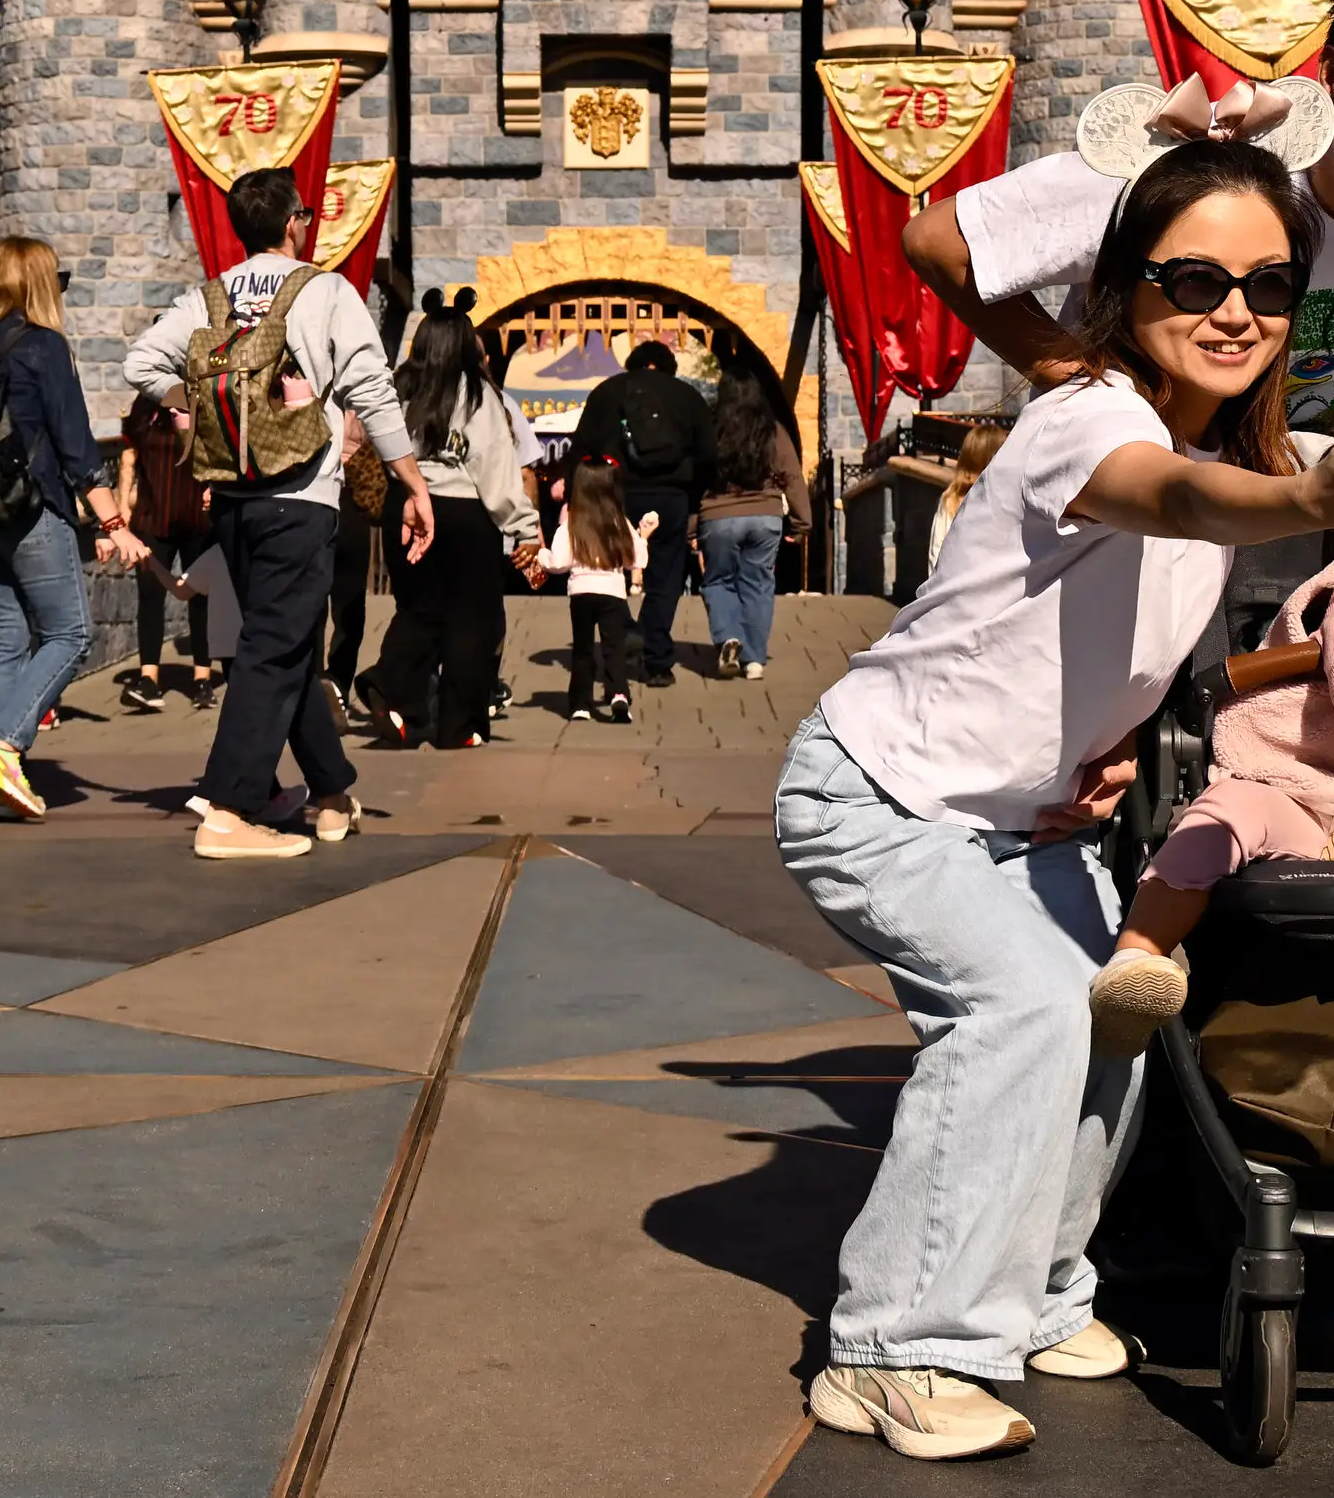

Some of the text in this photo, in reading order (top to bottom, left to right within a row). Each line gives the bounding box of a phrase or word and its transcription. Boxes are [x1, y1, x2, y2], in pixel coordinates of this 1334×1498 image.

[214, 93, 276, 136] 70
[883, 87, 947, 128] 70
[321, 186, 344, 221] 0
[248, 272, 286, 296] NAV
